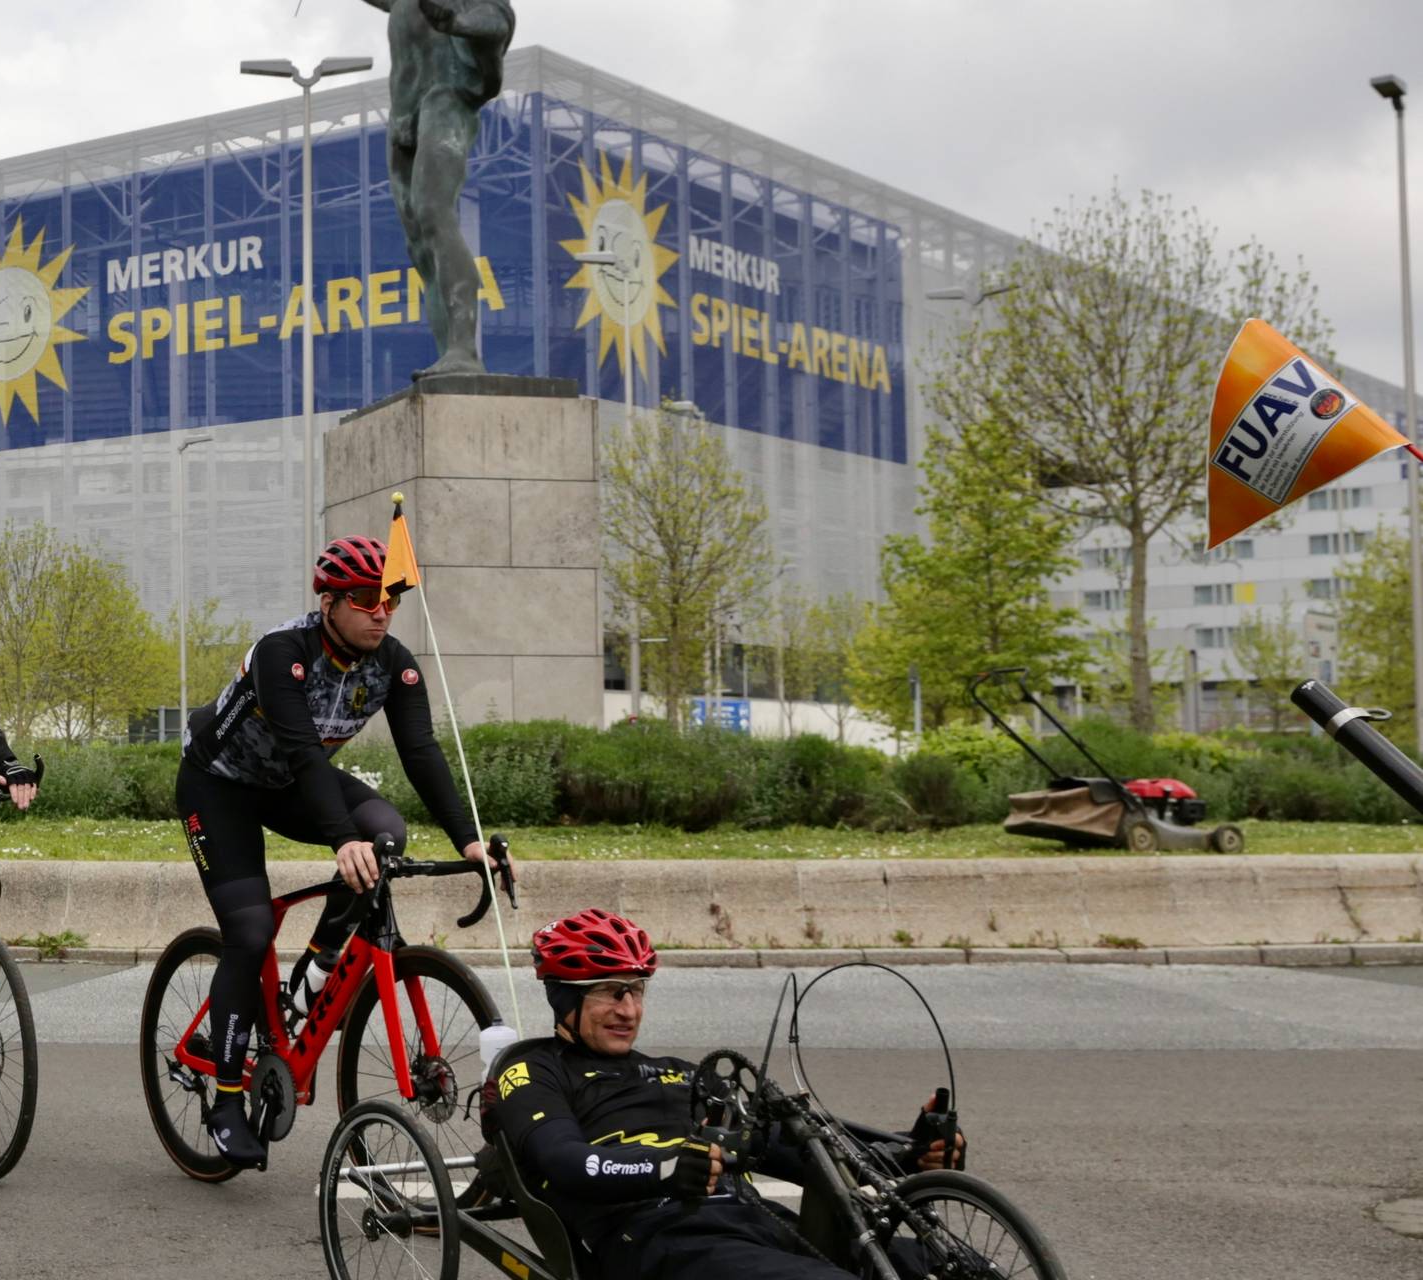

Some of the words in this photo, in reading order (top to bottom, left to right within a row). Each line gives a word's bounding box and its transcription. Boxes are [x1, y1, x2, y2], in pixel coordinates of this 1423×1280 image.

[107, 236, 263, 294] MERKUR
[689, 235, 780, 295] MERKUR
[691, 293, 891, 394] SPIEL-ARENA
[1216, 359, 1317, 482] FUAV
[225, 1012, 240, 1064] Bundeswehr
[601, 1158, 654, 1175] Germania
